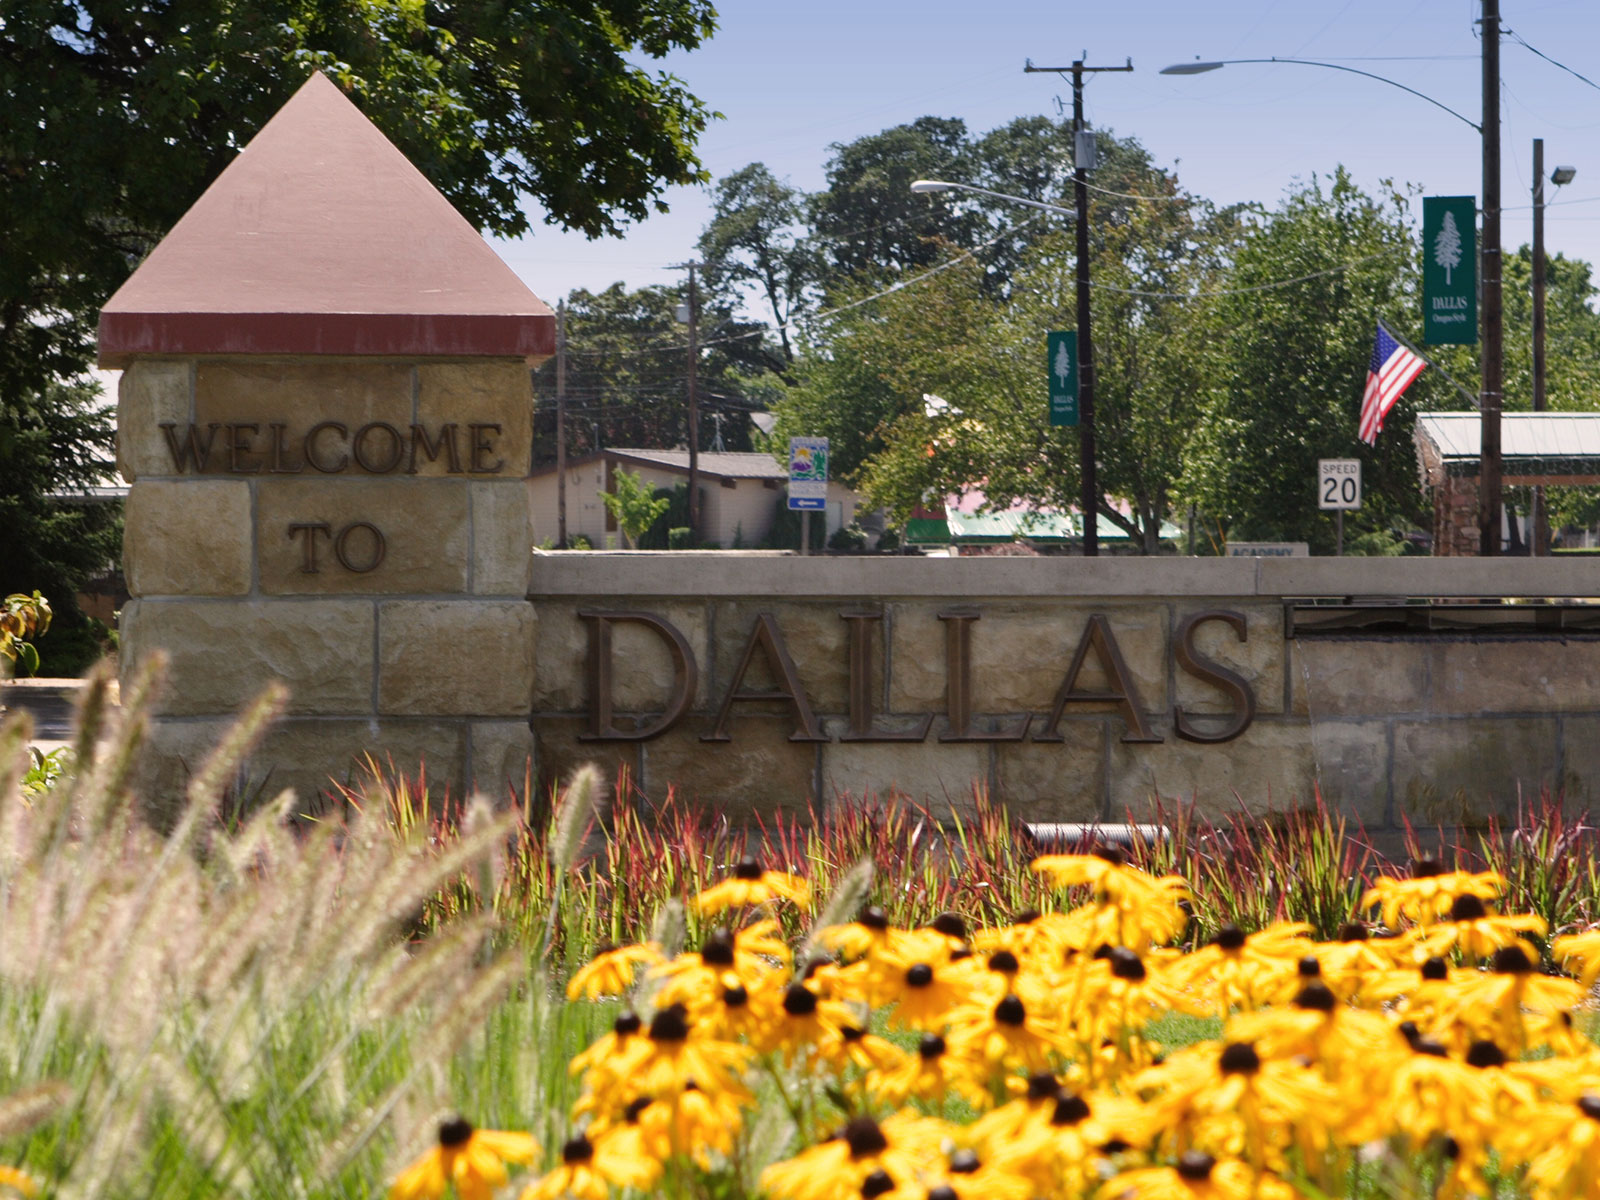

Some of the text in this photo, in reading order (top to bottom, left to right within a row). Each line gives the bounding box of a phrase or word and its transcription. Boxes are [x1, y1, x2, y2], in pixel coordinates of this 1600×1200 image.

[1432, 296, 1467, 310] DALLAS
[158, 421, 504, 475] WELCOME
[1322, 464, 1357, 474] SPEED
[1323, 477, 1356, 503] 20
[287, 521, 387, 575] TO
[578, 608, 1256, 744] DALLAS
